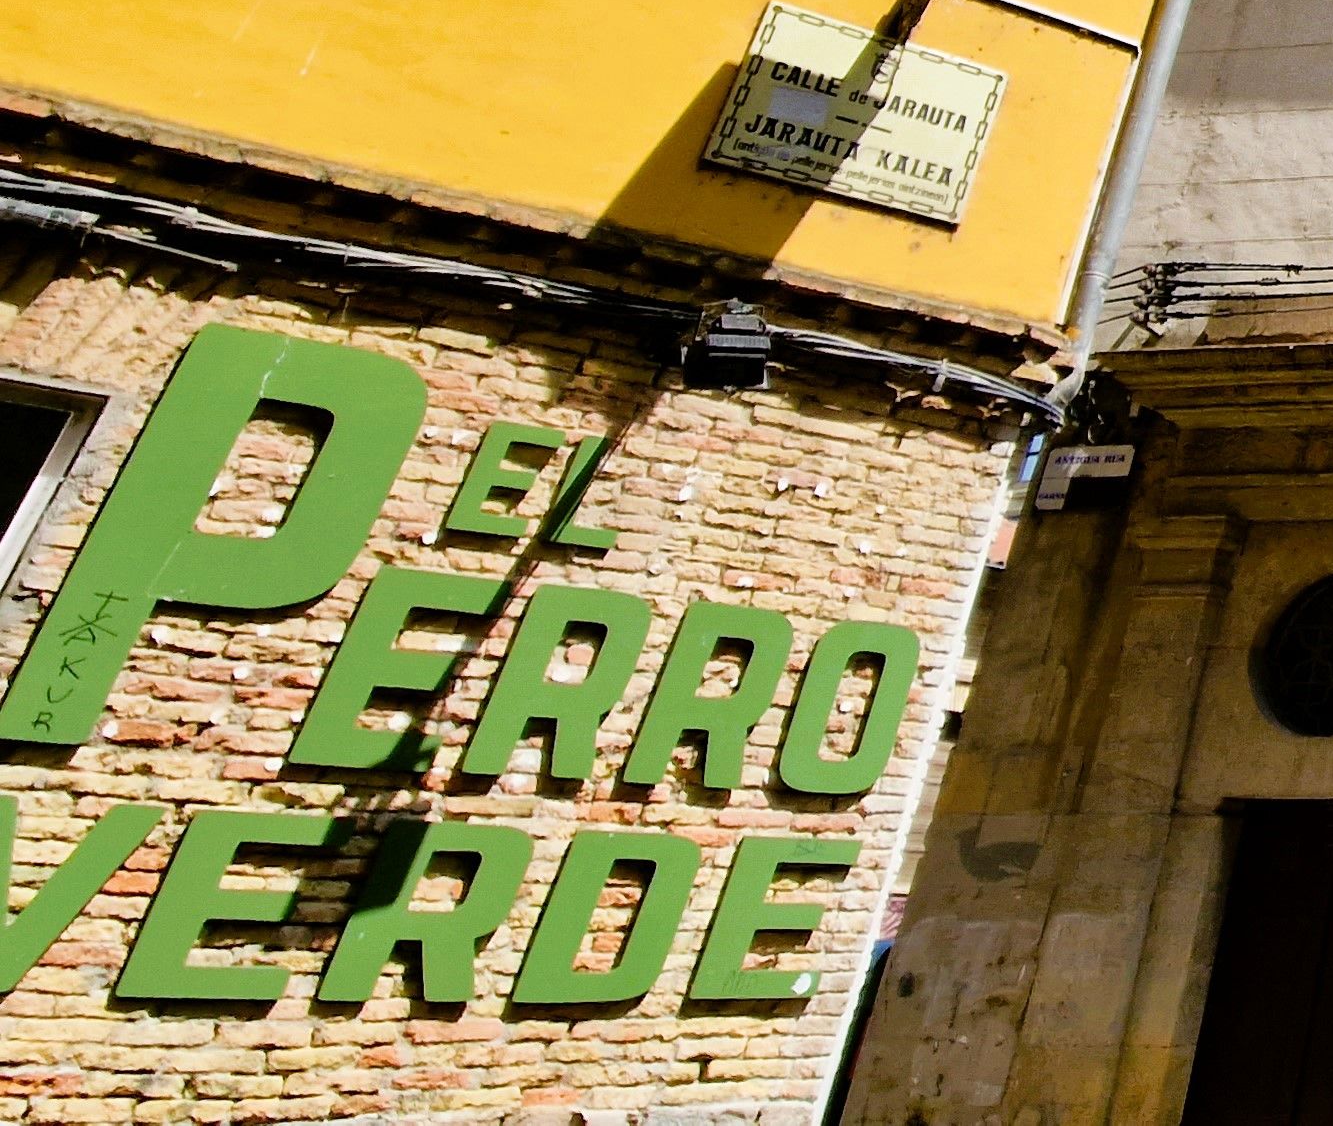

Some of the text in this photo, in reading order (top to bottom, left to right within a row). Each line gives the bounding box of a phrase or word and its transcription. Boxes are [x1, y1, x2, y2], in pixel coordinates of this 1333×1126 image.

[770, 60, 968, 134] CALLE de JARAUTA
[744, 114, 954, 187] JARAUTA KALEA
[445, 420, 618, 549] EL
[0, 322, 921, 795] PERRO
